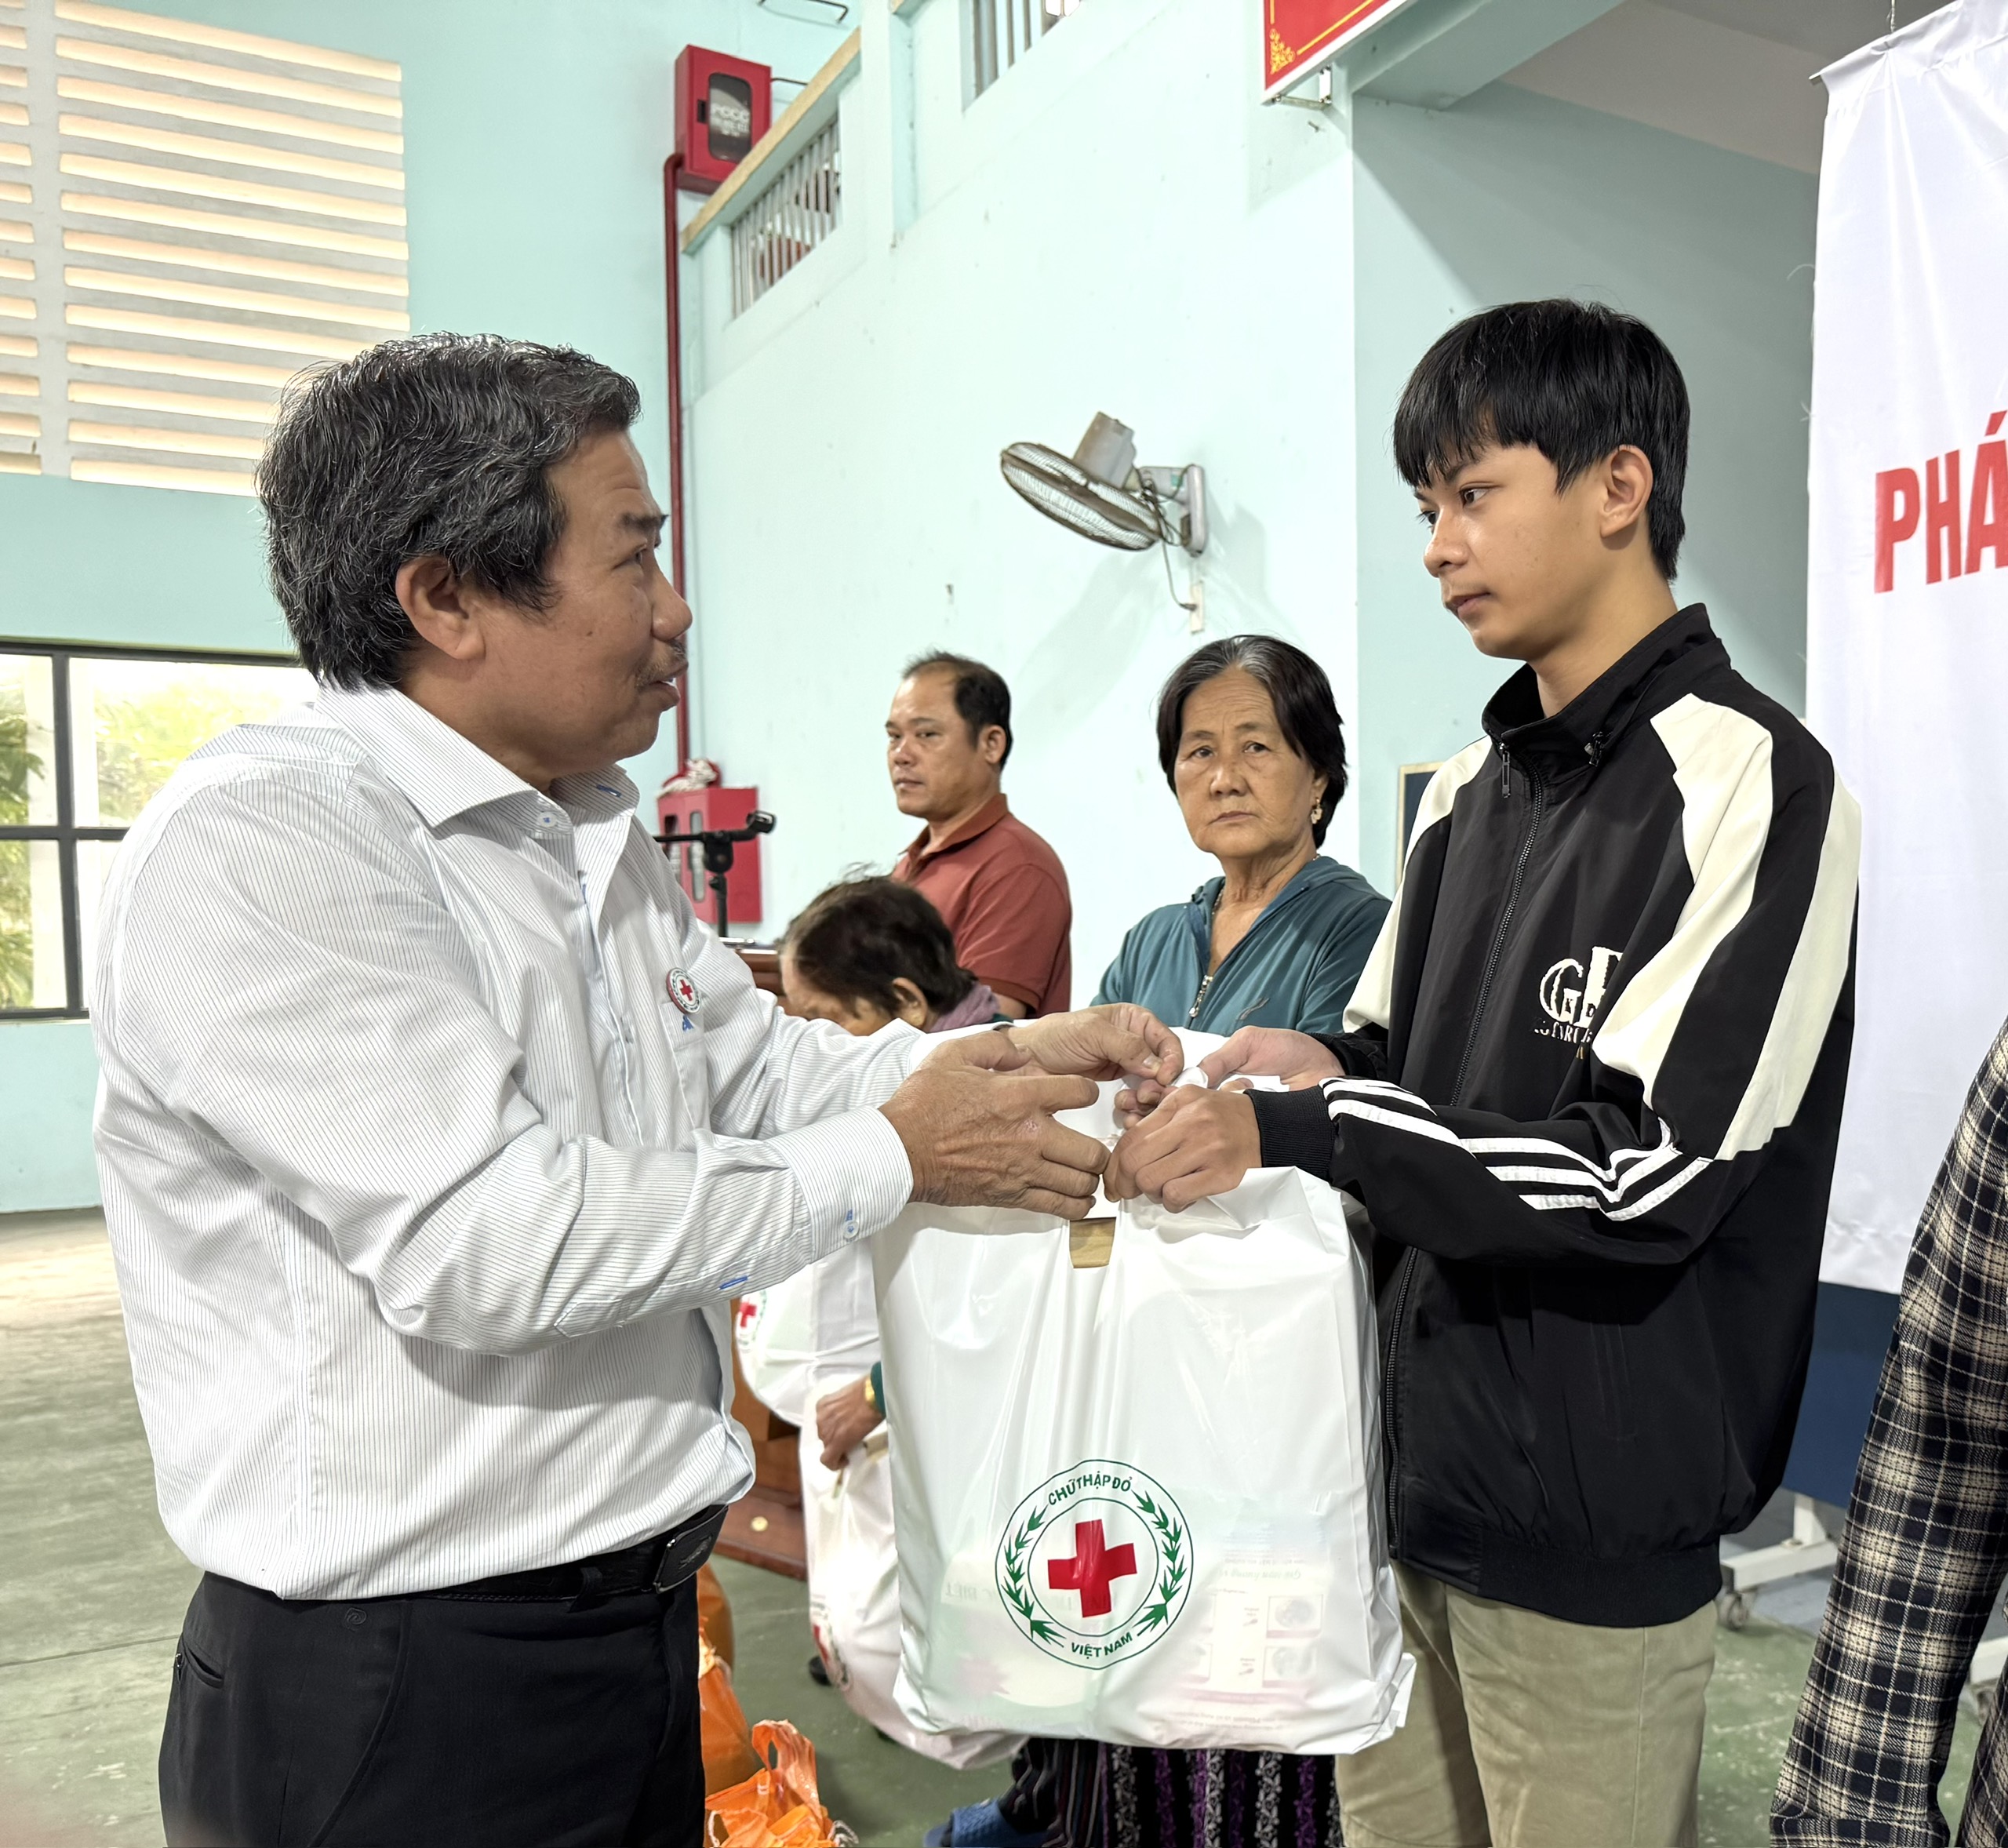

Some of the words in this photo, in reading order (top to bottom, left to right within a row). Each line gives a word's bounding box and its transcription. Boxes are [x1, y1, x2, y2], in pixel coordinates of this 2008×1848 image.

[1874, 409, 2008, 594] PHÁ
[1111, 1476, 1133, 1492] ĐỎ
[1071, 1642, 1102, 1659] VIỆT
[1104, 1632, 1133, 1656] NAM
